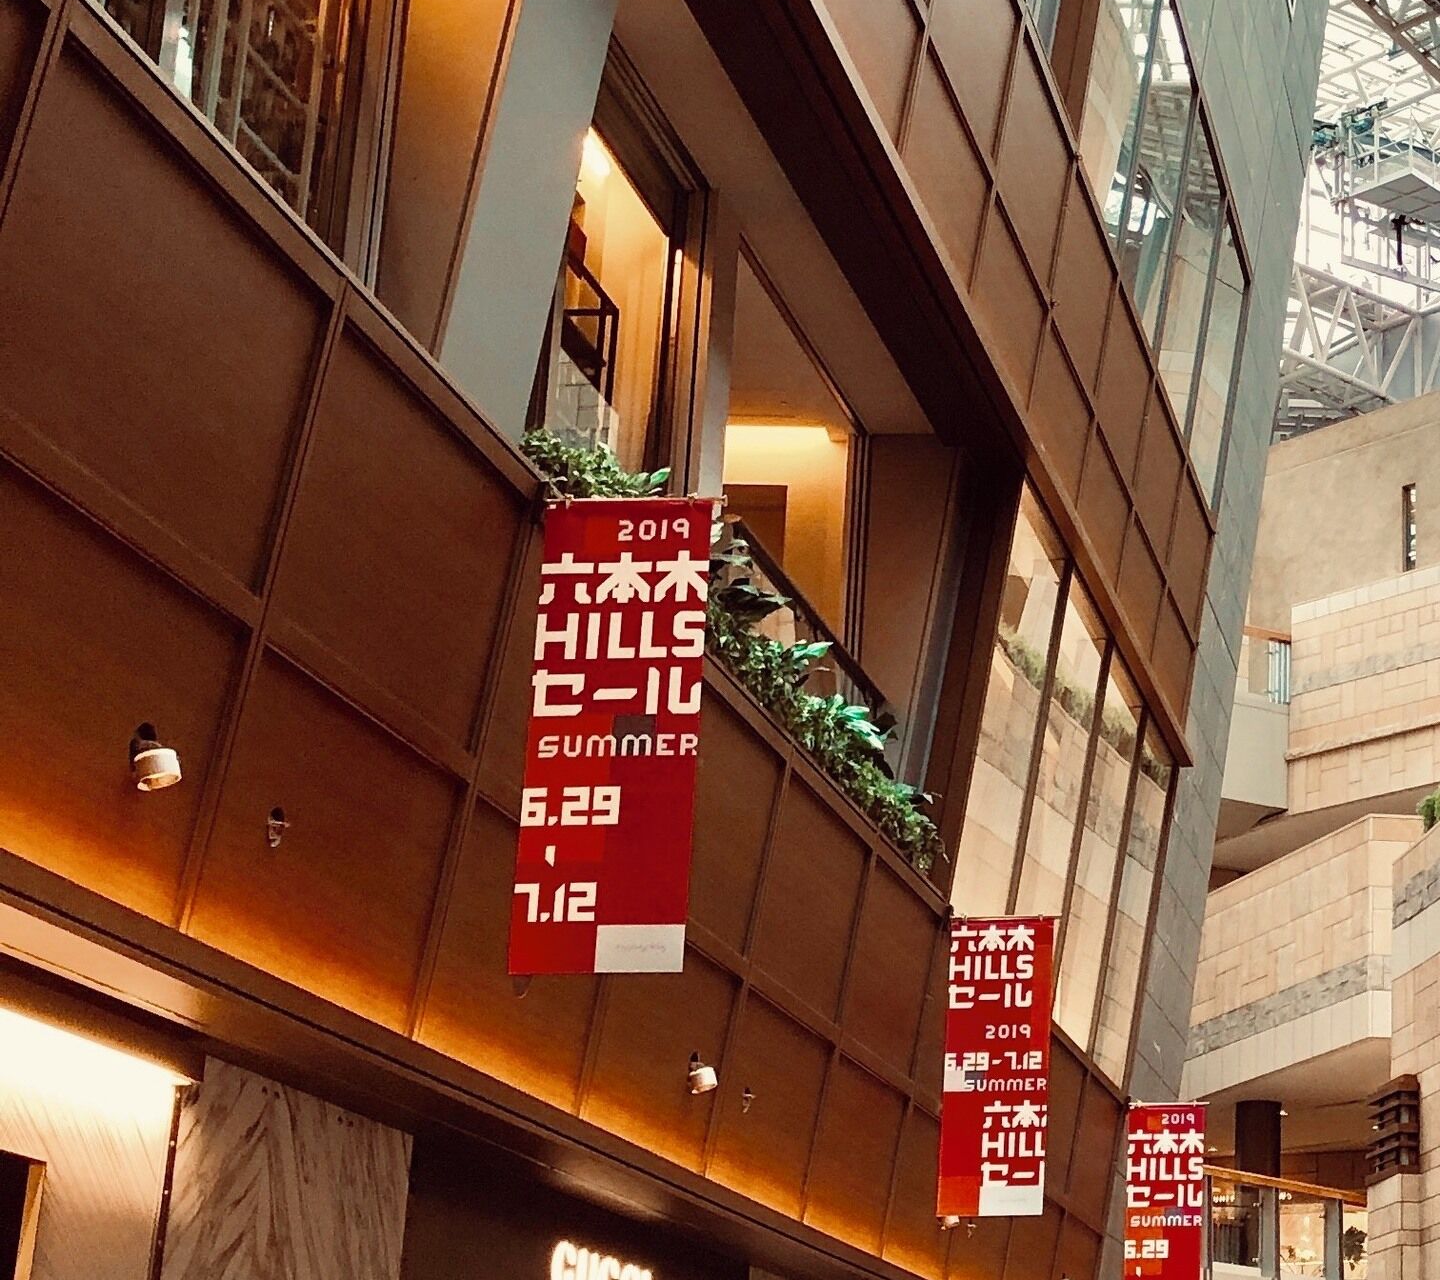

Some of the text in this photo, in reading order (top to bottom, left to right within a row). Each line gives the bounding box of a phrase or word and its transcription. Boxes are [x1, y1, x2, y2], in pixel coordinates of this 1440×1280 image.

[617, 518, 690, 542] 2019
[539, 550, 710, 604] 六本木
[534, 610, 706, 661] HILLS
[532, 666, 702, 717] セール
[538, 733, 699, 759] SUMMER
[520, 786, 621, 827] 6.29
[514, 882, 598, 923] 7.12
[950, 924, 1035, 952] 六本木
[949, 954, 1034, 981] HILLS
[948, 982, 1033, 1009] セール
[985, 1024, 1031, 1039] 2019
[965, 1078, 1047, 1092] SUMMER
[982, 1100, 1048, 1129] 六本
[1161, 1113, 1195, 1125] 2019
[1127, 1128, 1205, 1154] 六本木
[1126, 1156, 1204, 1181] HILLS
[1126, 1183, 1203, 1207] セール
[1130, 1214, 1202, 1227] SUMMER
[1124, 1239, 1169, 1259] 6.29
